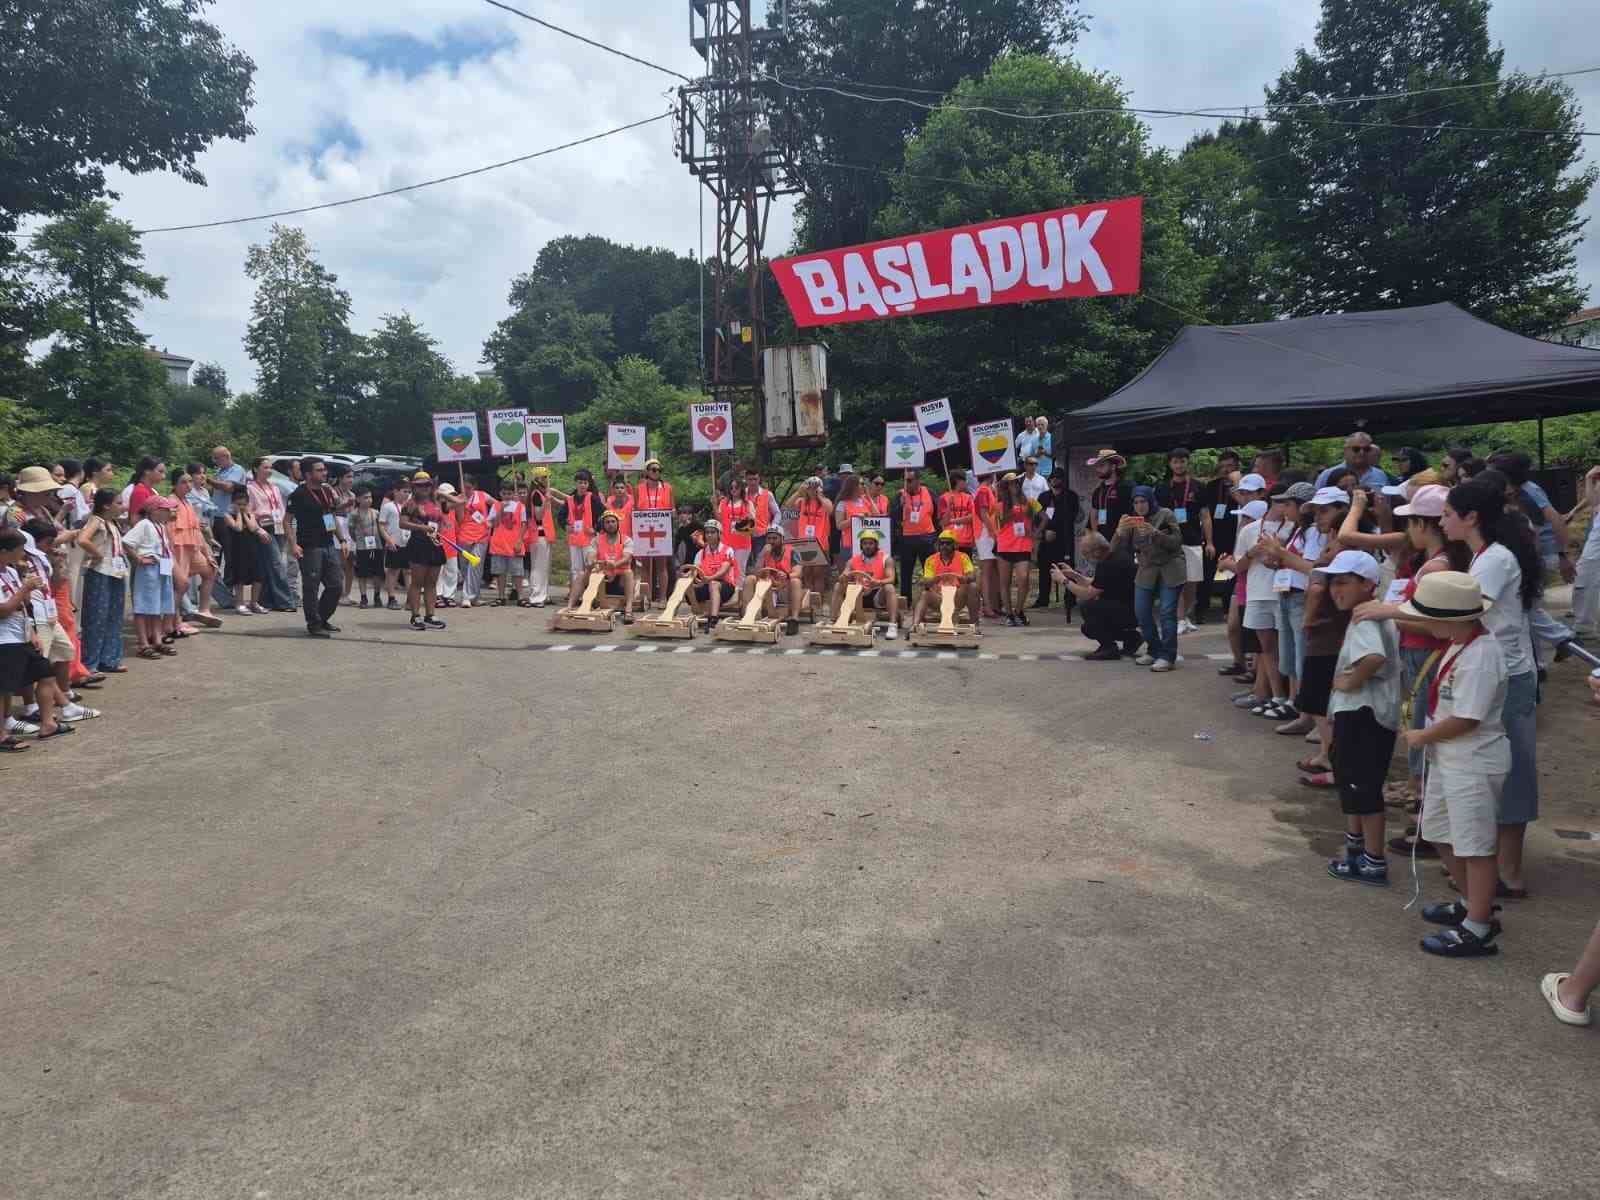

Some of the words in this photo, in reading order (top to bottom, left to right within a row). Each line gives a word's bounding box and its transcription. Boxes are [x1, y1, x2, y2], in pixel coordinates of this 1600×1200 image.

[792, 209, 1113, 316] BAŞLADUK
[694, 402, 729, 413] TÜRKİYE
[921, 401, 944, 413] RUSYA
